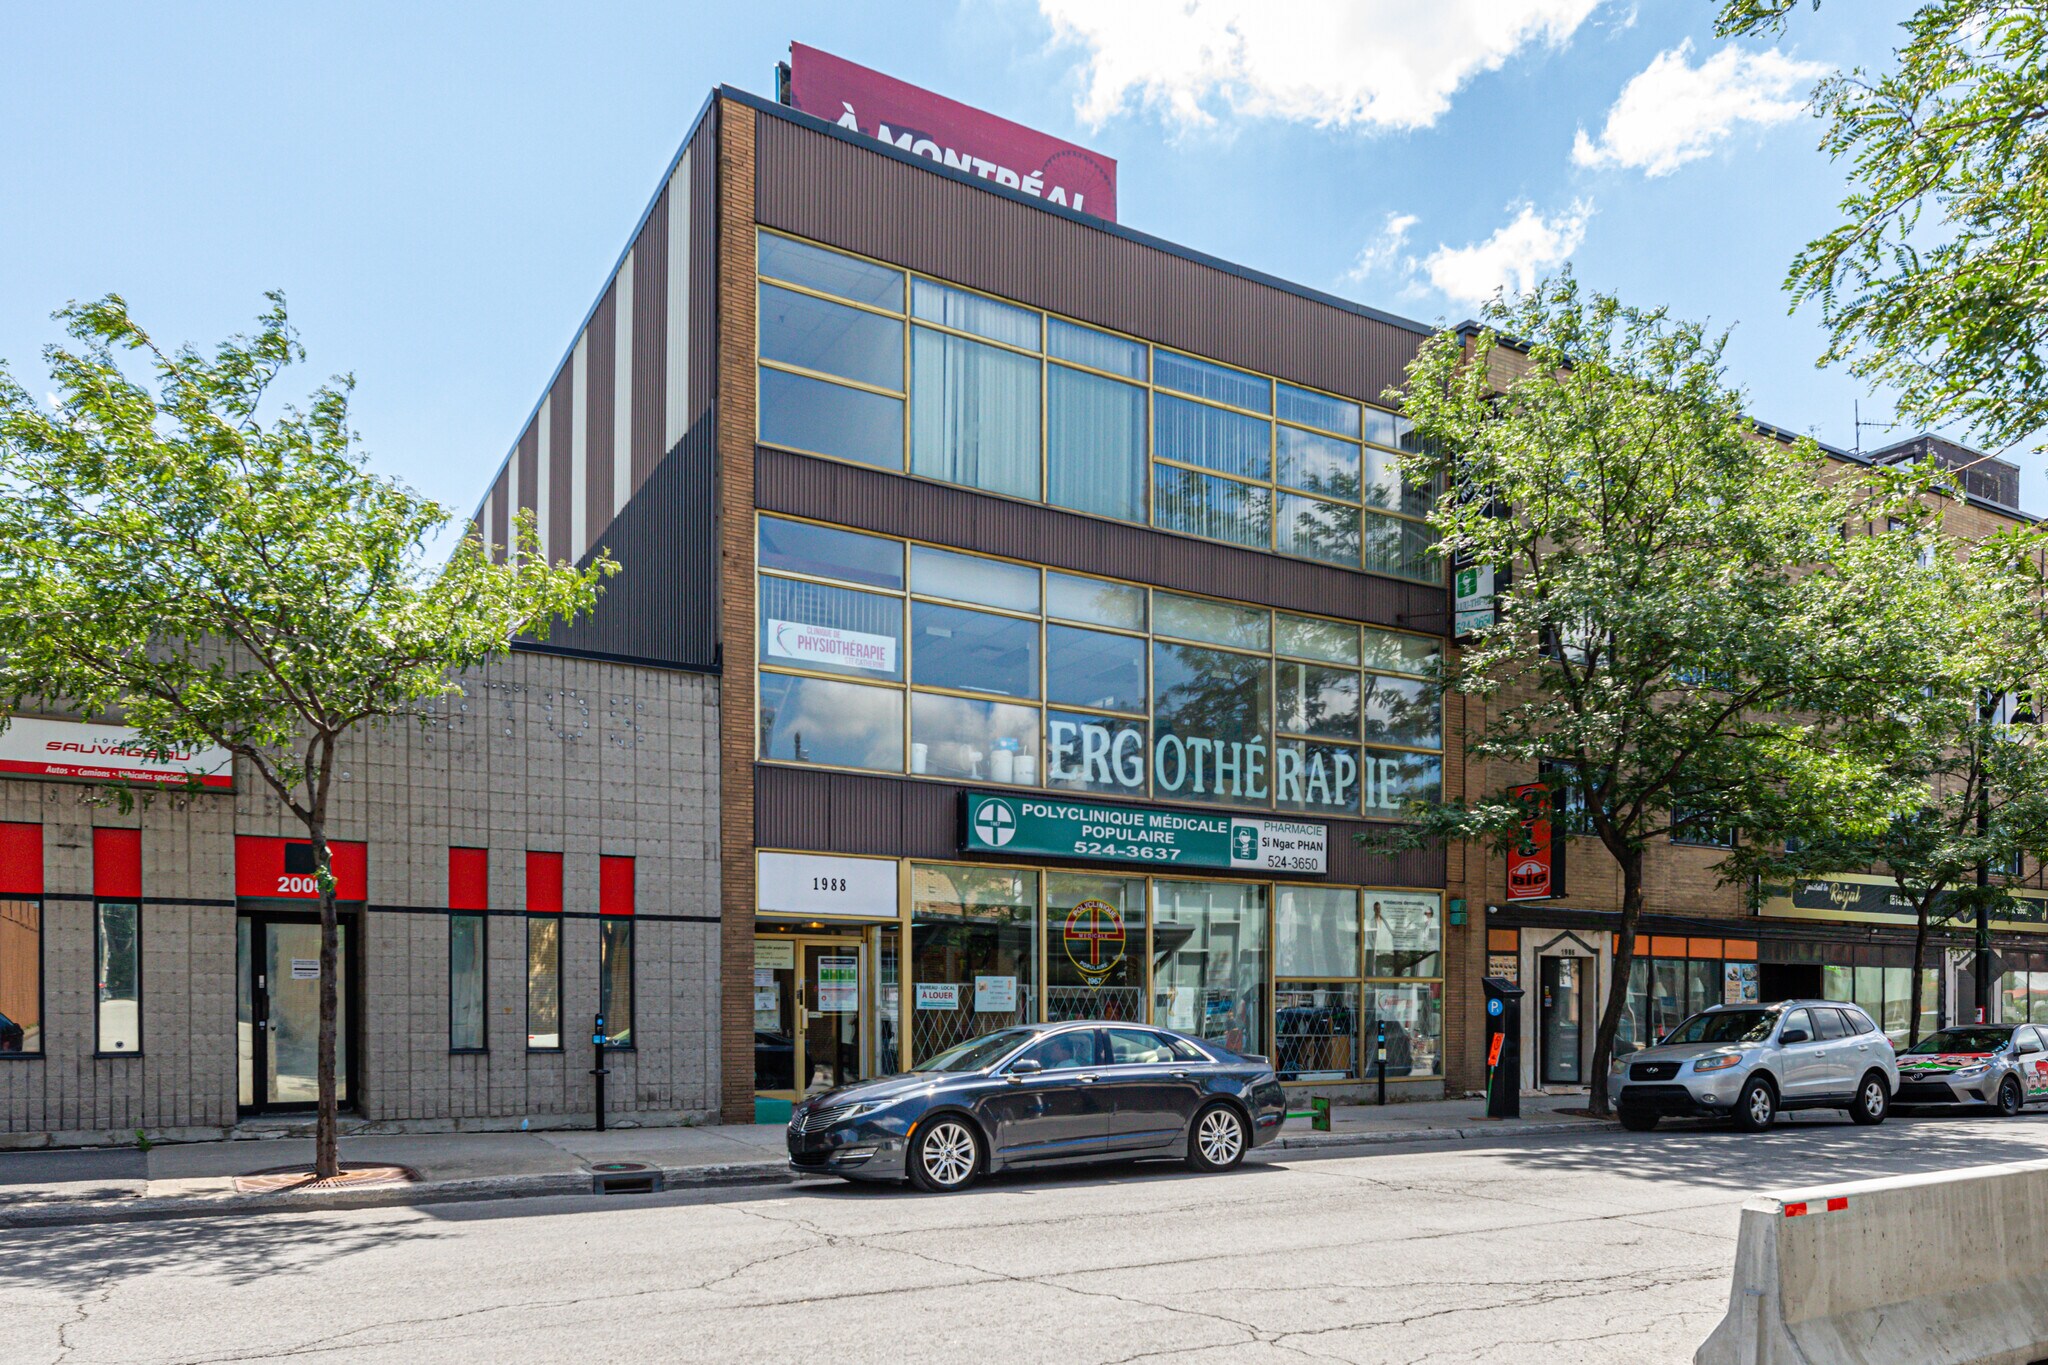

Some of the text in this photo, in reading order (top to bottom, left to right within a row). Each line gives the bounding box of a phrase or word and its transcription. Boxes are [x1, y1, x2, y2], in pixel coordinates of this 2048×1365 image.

[797, 635, 886, 660] PHYSIOTHÉRAPIE
[45, 765, 68, 775] Autos
[77, 768, 110, 778] Camions
[1022, 803, 1228, 834] POLYCLINIQUE MÉDICALE
[1082, 825, 1175, 844] POPULAIRE
[1264, 821, 1322, 836] PHARMACIE
[1074, 841, 1181, 860] 524-3637
[1262, 837, 1323, 851] Si Ngac PHAN
[1268, 855, 1318, 870] 524-3650
[813, 877, 847, 891] 1988
[1512, 874, 1547, 886] BIG
[1073, 901, 1117, 918] POLYCLINIQUE
[922, 990, 954, 999] À LOUER
